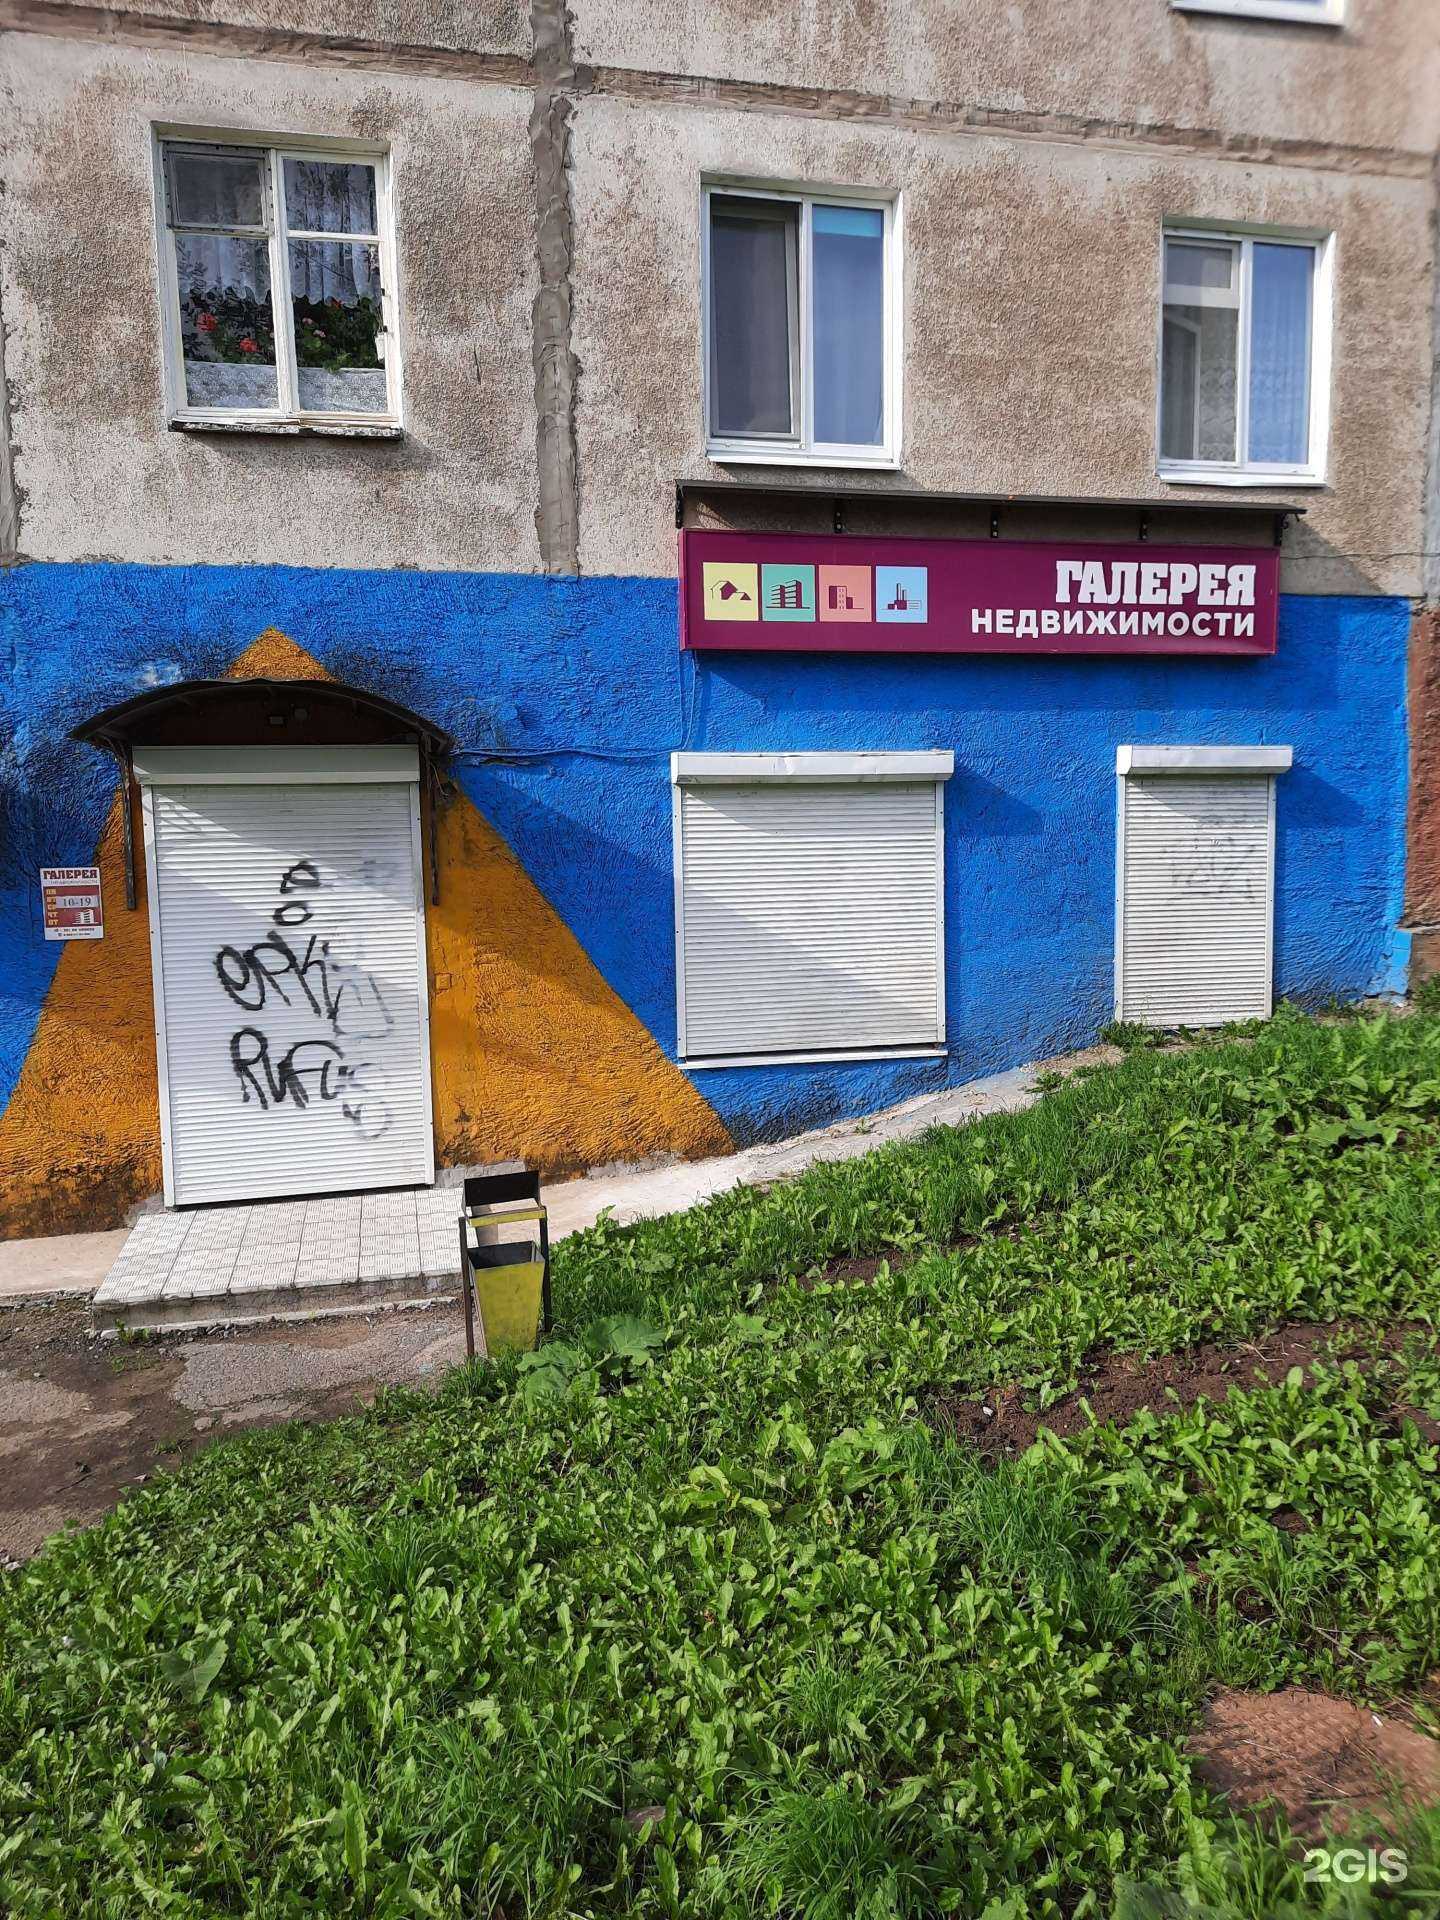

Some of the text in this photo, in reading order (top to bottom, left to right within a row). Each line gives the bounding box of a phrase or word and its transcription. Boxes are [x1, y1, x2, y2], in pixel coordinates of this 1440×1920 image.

[1055, 560, 1257, 606] ГАЛЕРЕЯ
[971, 608, 1255, 639] НЕДВИЖИМОСТИ
[43, 870, 97, 879] ГАЛЕРЕЯ
[63, 897, 92, 907] 10-19
